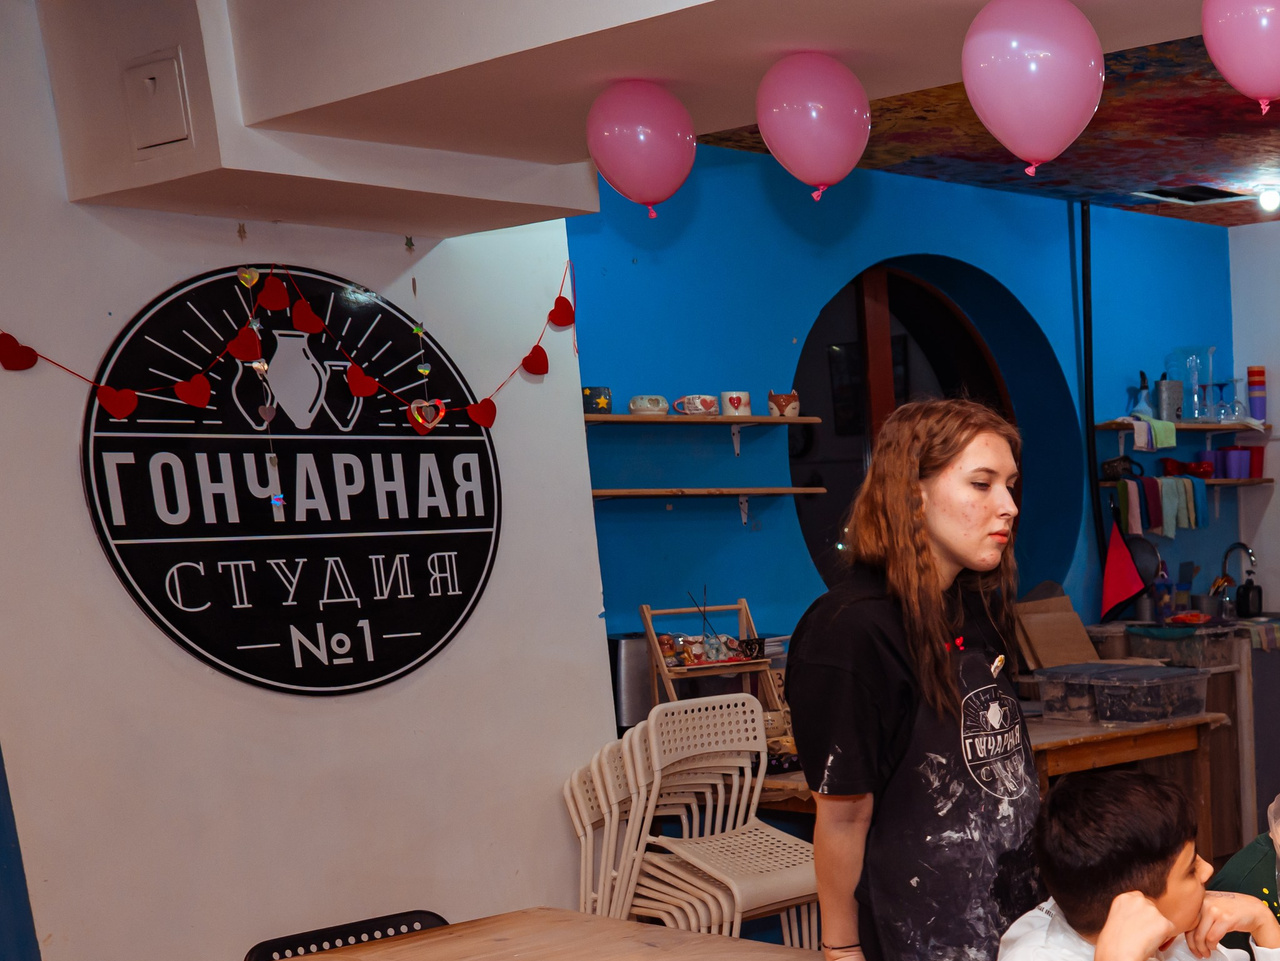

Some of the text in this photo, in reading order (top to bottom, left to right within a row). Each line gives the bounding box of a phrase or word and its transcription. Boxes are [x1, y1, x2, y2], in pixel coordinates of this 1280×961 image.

[102, 451, 485, 526] ГОНЧАРНАЯ
[164, 551, 463, 612] СТУДИЯ
[289, 619, 374, 668] №1
